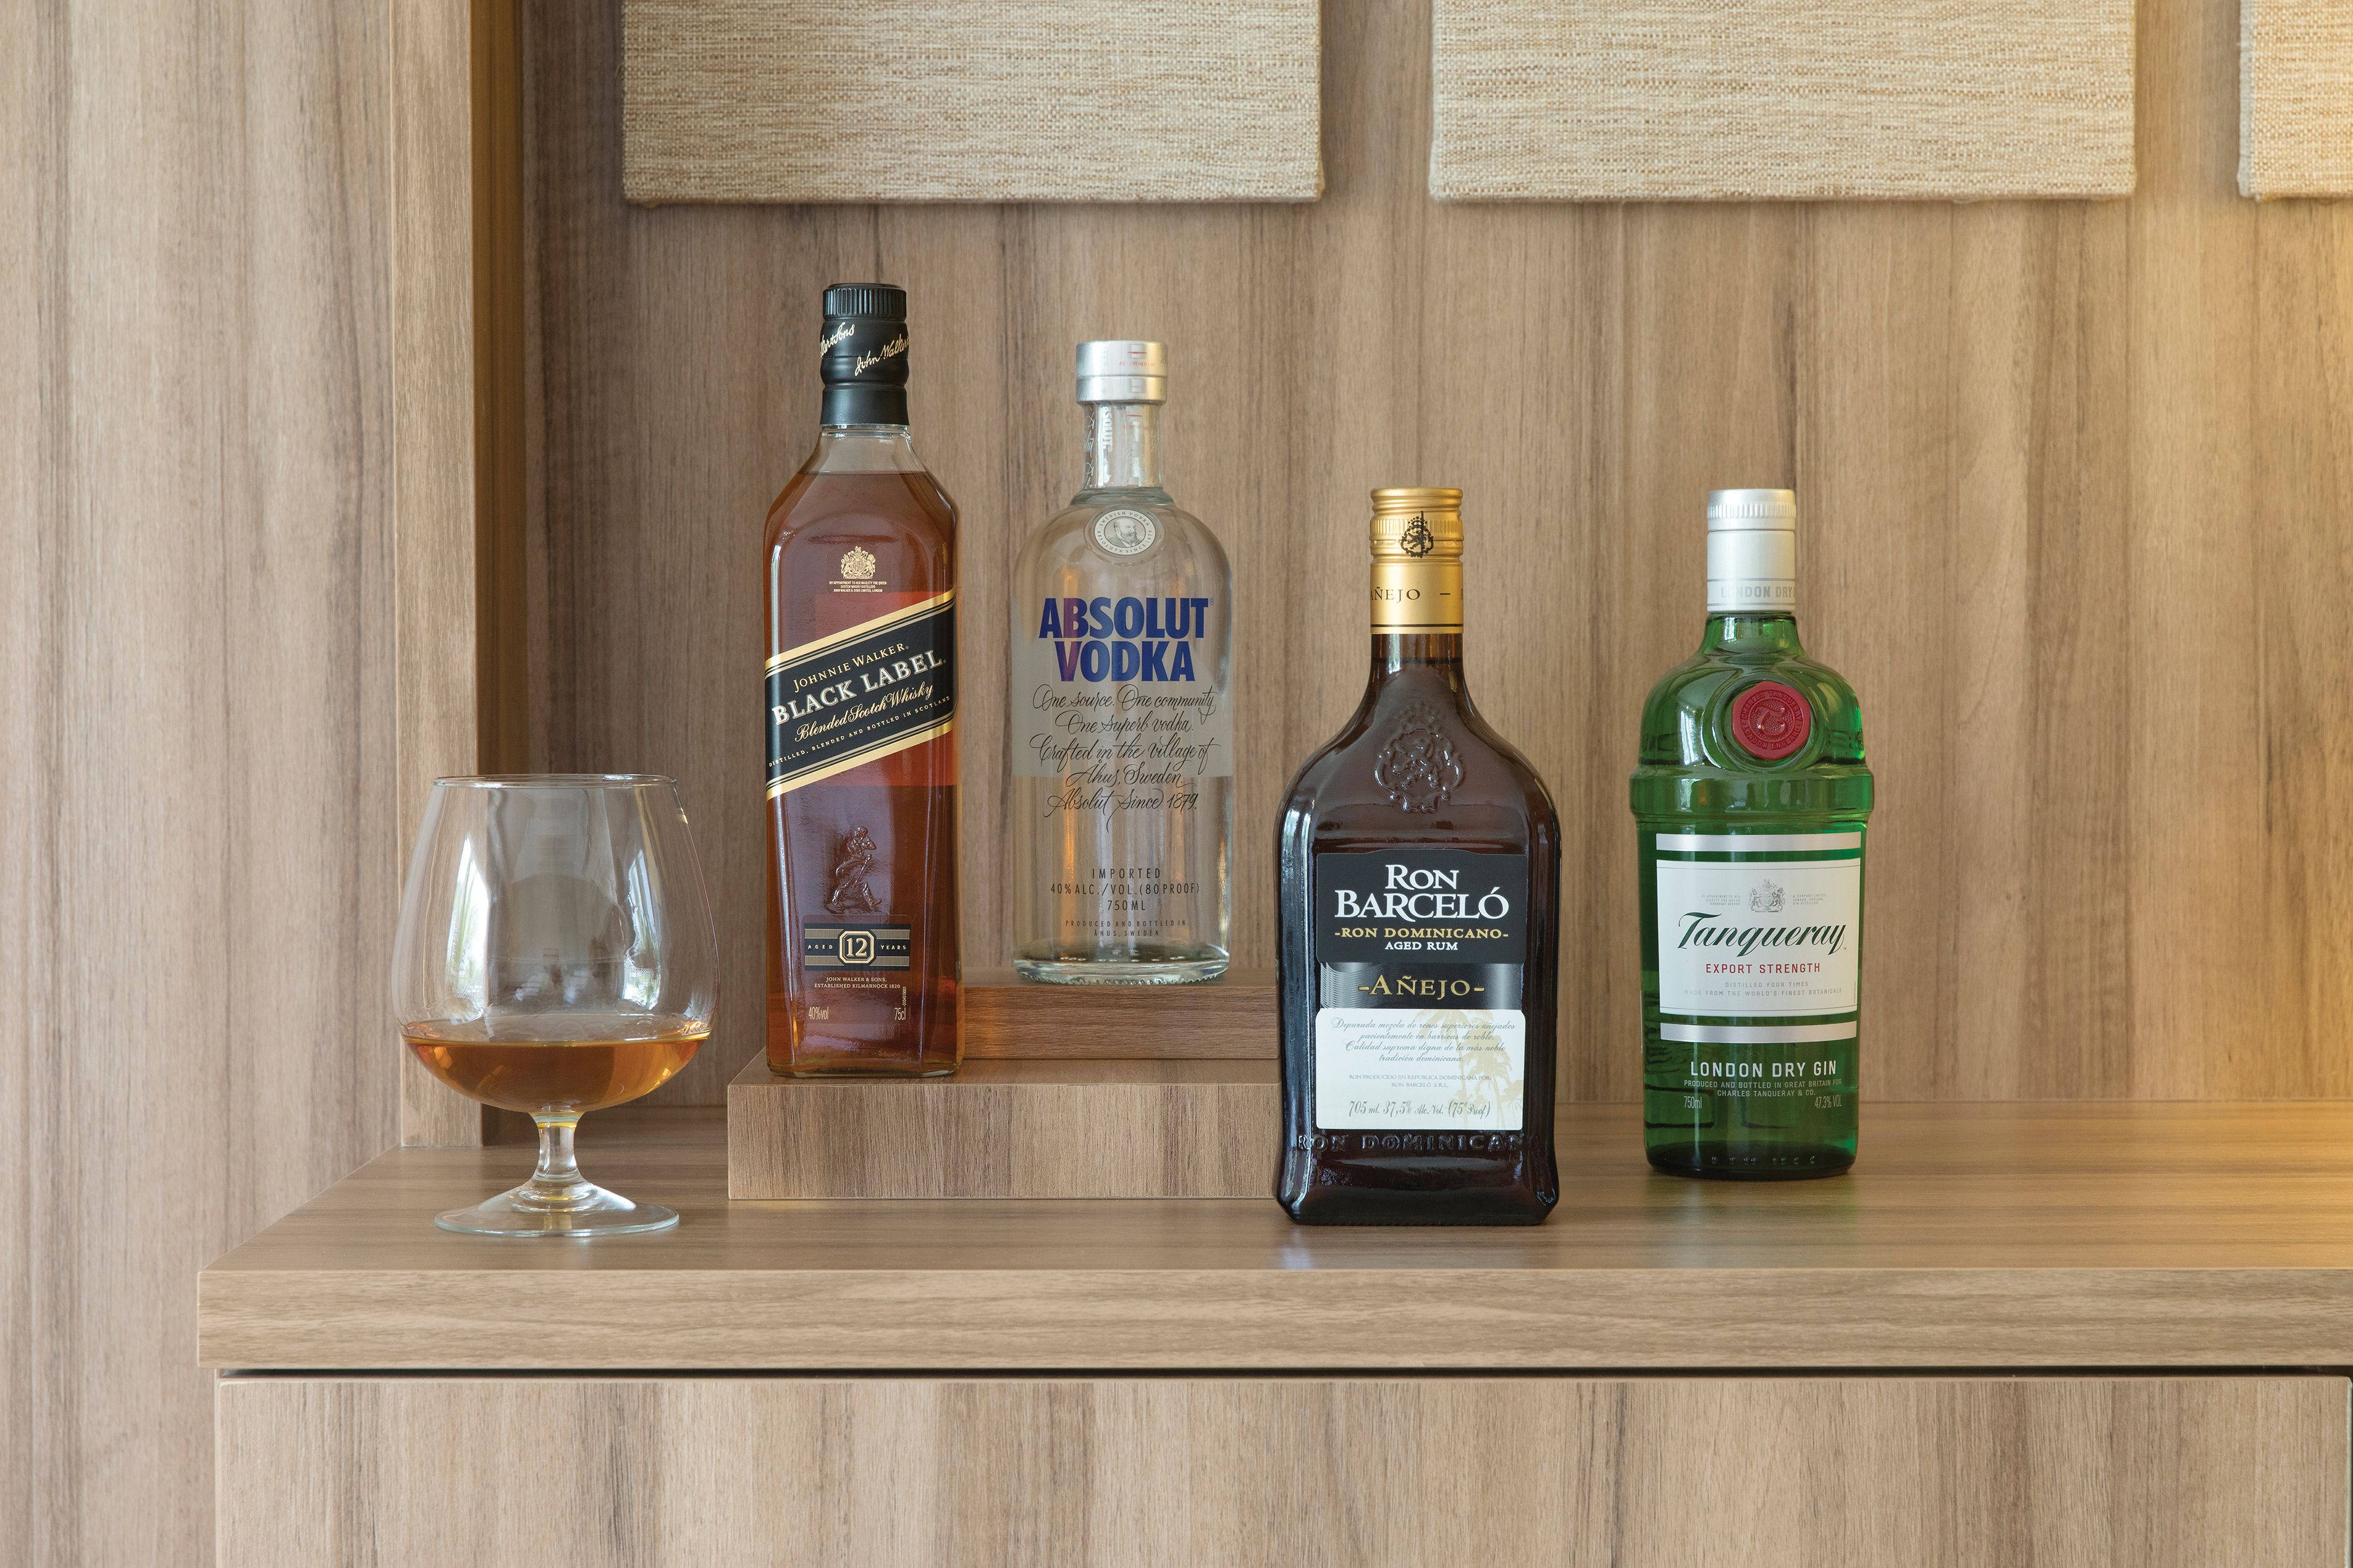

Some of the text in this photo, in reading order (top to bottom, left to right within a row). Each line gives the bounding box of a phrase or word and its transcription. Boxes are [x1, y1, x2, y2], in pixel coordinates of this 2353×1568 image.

[855, 350, 880, 377] John
[1129, 512, 1150, 526] VODKA
[1097, 530, 1118, 551] ABSOLUT
[1038, 597, 1209, 639] ABSOLUT
[793, 643, 905, 693] JOHNNIE WALKER
[1054, 640, 1195, 682] VODKA
[772, 649, 943, 726] BLACK LABEL
[1033, 684, 1067, 711] One
[1066, 692, 1114, 712] source.
[1117, 684, 1152, 711] One
[1741, 690, 1803, 721] CHARLES TANQUERAY
[794, 681, 934, 742] Blended Scotch Whisky
[768, 750, 809, 767] DISTILLED,
[812, 736, 845, 751] BLENDED
[849, 729, 863, 739] AND
[867, 715, 900, 731] BOTTLED
[915, 695, 950, 713] SCOTLAND
[1055, 710, 1193, 741] One superb vodka.
[1742, 726, 1801, 750] LONDON ENGLAND
[1029, 732, 1221, 775] Crafted in the village of
[1043, 787, 1123, 818] Absolut
[1166, 792, 1199, 815] 1879.
[1092, 868, 1160, 879] IMPORTED
[1677, 912, 1846, 957] Tanqueray
[846, 937, 868, 957] 12
[1385, 942, 1458, 950] AGED RUM
[1706, 963, 1821, 973] EXPORT STRENGTH
[1809, 987, 1843, 996] BOTANICALS
[894, 1007, 906, 1020] 75cl
[1331, 1017, 1376, 1031] Depurada
[1378, 1019, 1404, 1031] mezcla
[1407, 1020, 1416, 1028] de
[1441, 1023, 1479, 1033] superiores
[1481, 1020, 1515, 1033] añejados
[1357, 1032, 1413, 1042] pacientemente
[1427, 1031, 1459, 1040] barricas
[1462, 1031, 1471, 1040] de
[1474, 1031, 1494, 1040] roble.
[1342, 1039, 1383, 1052] Calidad
[1383, 1045, 1415, 1054] suprema
[1418, 1042, 1441, 1054] digna
[1444, 1042, 1453, 1050] de
[1455, 1042, 1464, 1051] la
[1485, 1042, 1505, 1051] noble
[1379, 1052, 1464, 1062] tradición dominicana.
[1691, 1060, 1836, 1078] LONDON DRY GIN
[1684, 1080, 1717, 1088] PRODUCED
[1808, 1080, 1831, 1088] BRITAIN
[1383, 1100, 1412, 1117] 37,5%
[1683, 1096, 1703, 1109] 750ml
[1814, 1094, 1842, 1109] 47.3% VOL
[1298, 1134, 1350, 1152] RON
